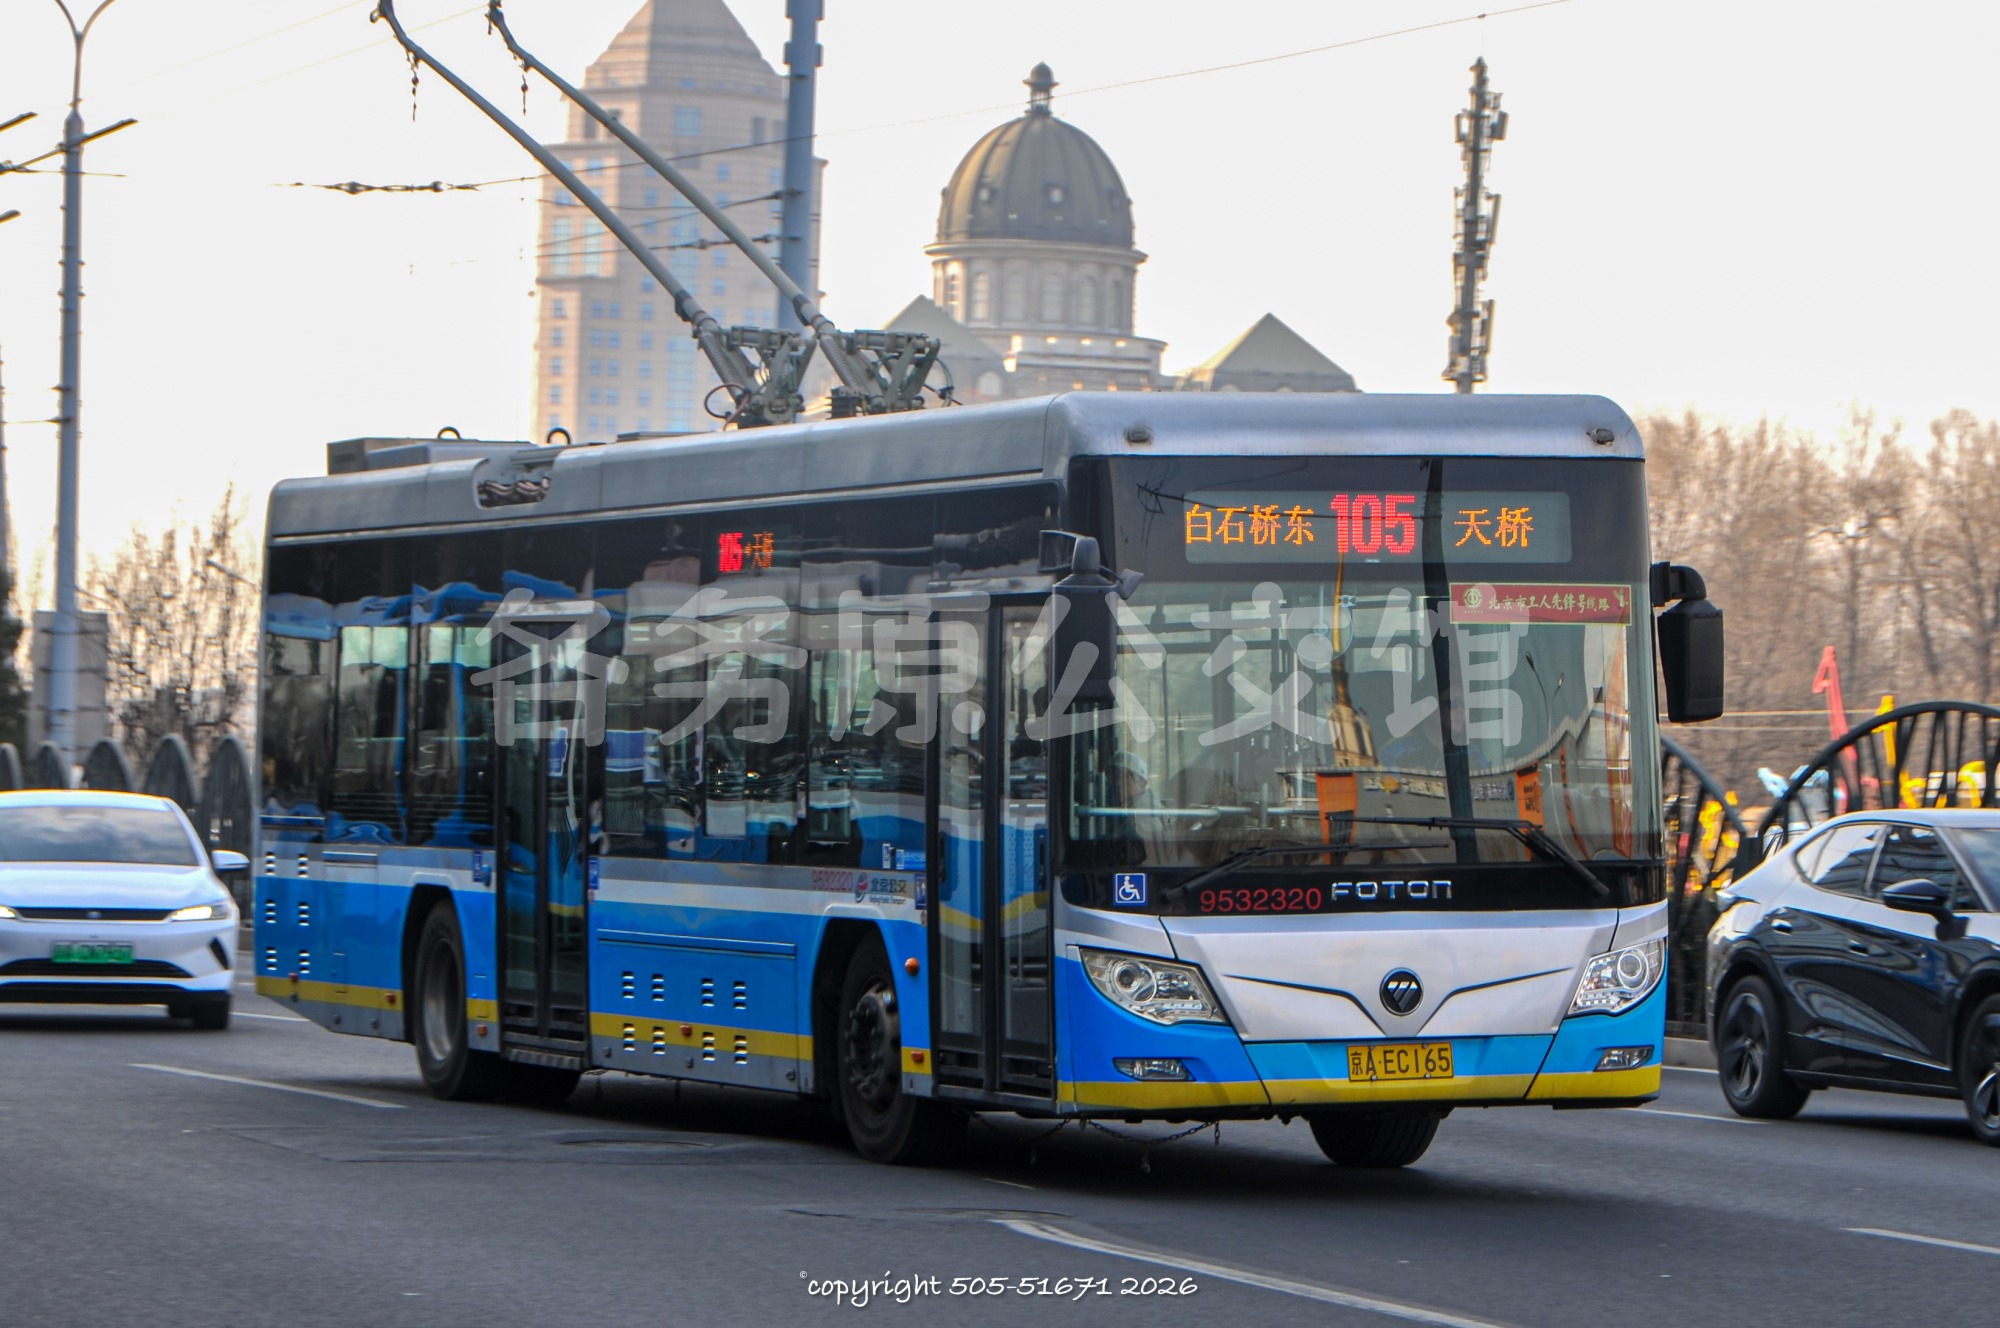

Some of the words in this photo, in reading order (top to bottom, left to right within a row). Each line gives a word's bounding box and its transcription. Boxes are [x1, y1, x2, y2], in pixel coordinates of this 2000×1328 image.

[1184, 503, 1315, 546] 白石桥东
[1330, 493, 1416, 554] 105
[1453, 506, 1534, 548] 天桥
[870, 877, 907, 893] 北京公交
[1331, 879, 1453, 902] FOTON
[1200, 887, 1322, 913] 9532320
